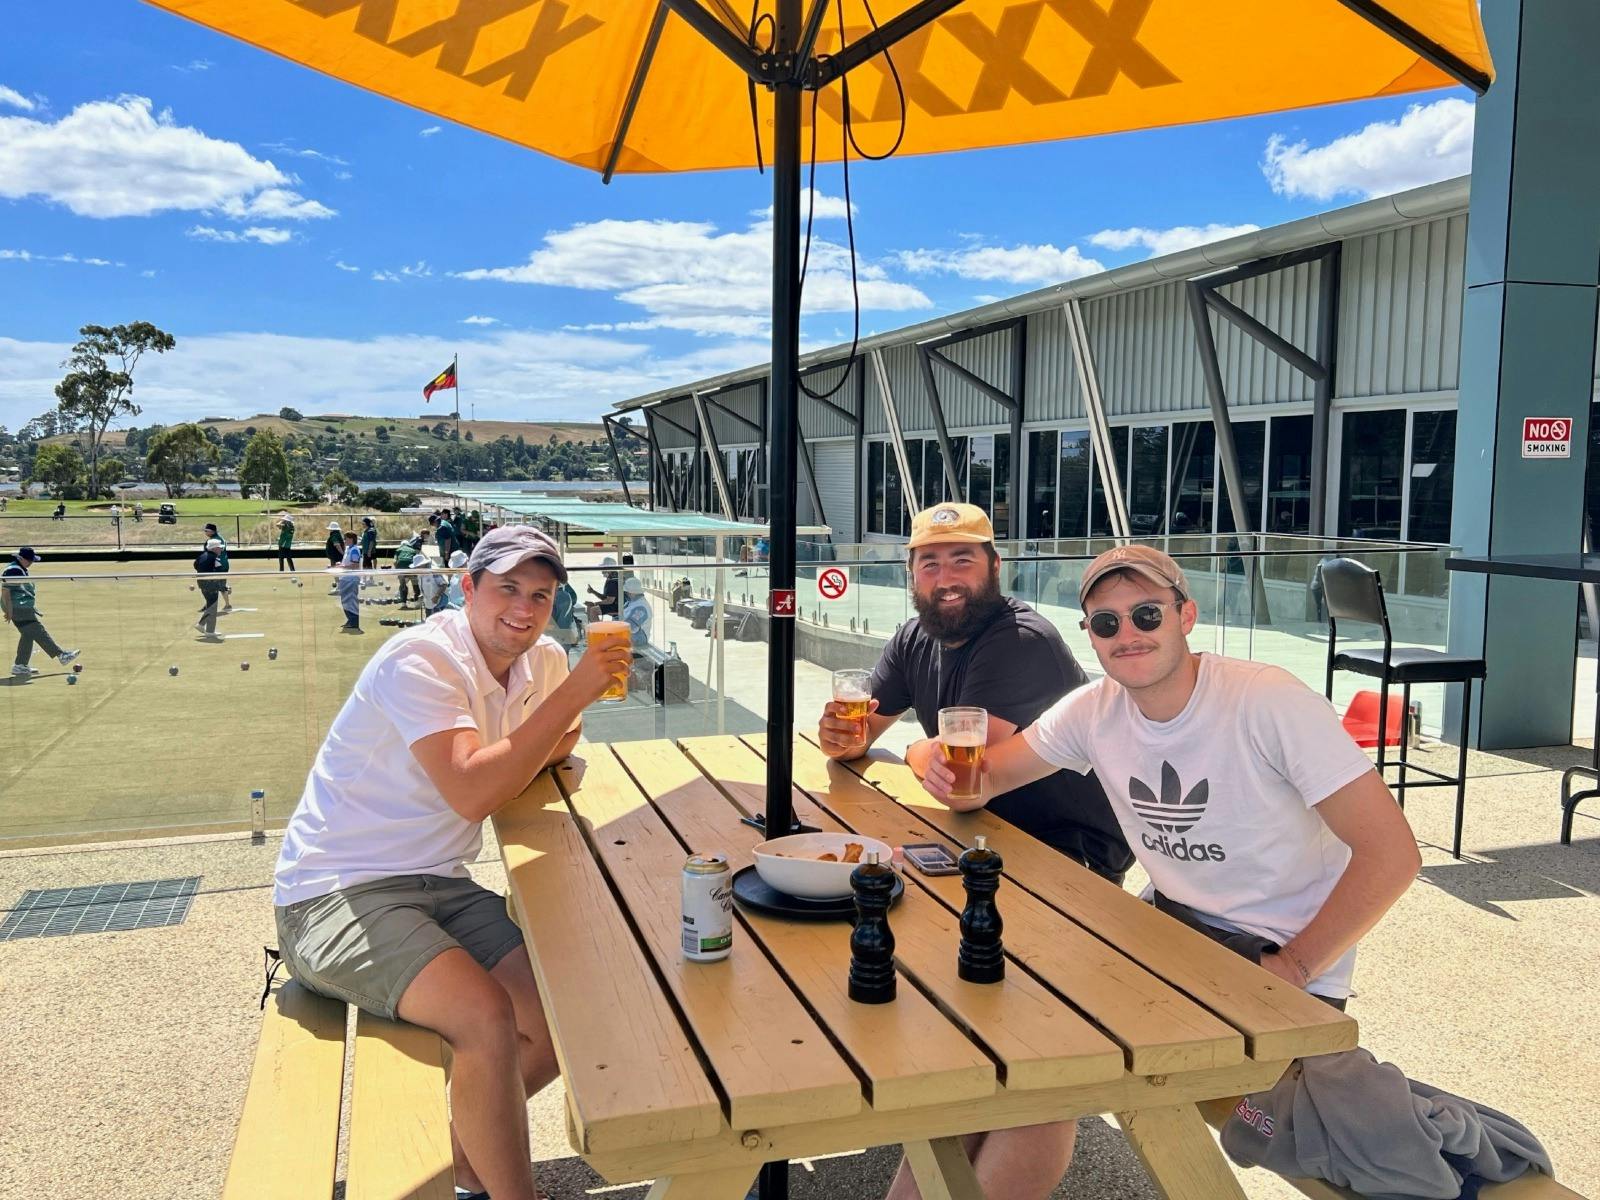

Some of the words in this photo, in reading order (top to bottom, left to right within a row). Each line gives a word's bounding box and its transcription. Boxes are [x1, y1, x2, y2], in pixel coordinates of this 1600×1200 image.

[1529, 423, 1550, 438] NO
[1527, 444, 1566, 452] SMOKING
[1141, 832, 1226, 862] adidas
